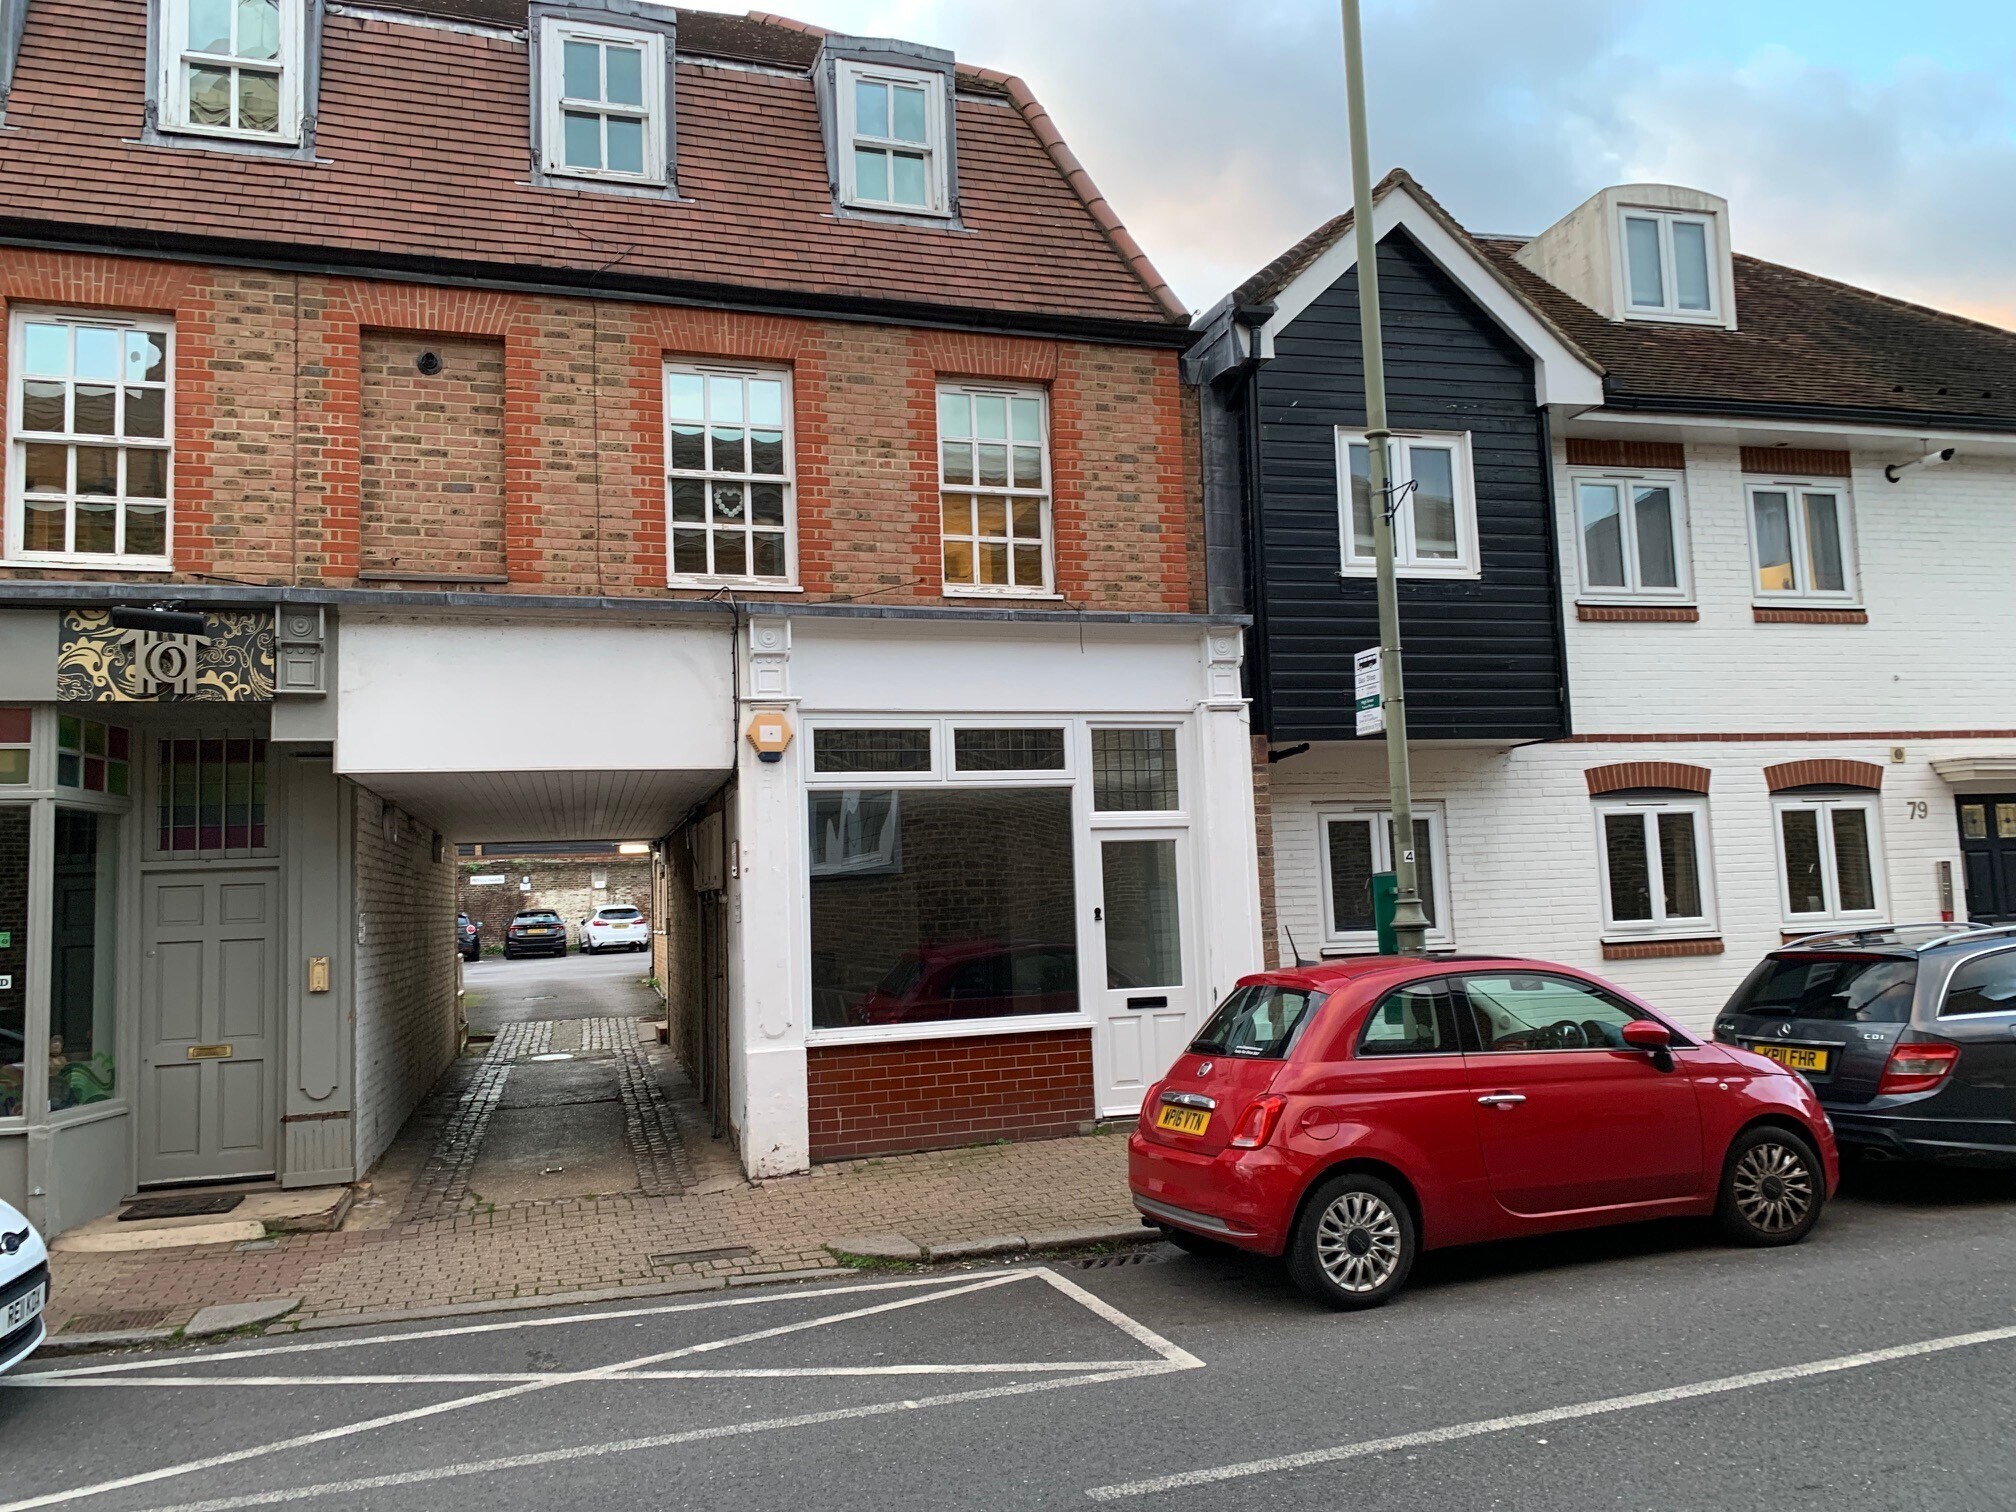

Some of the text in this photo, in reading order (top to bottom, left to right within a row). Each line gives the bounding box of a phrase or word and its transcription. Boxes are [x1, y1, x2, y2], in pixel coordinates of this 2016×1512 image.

[1906, 801, 1928, 820] 79
[1405, 851, 1413, 861] 4
[1789, 1050, 1816, 1067] FHR
[1162, 1108, 1205, 1131] WP16 VTN
